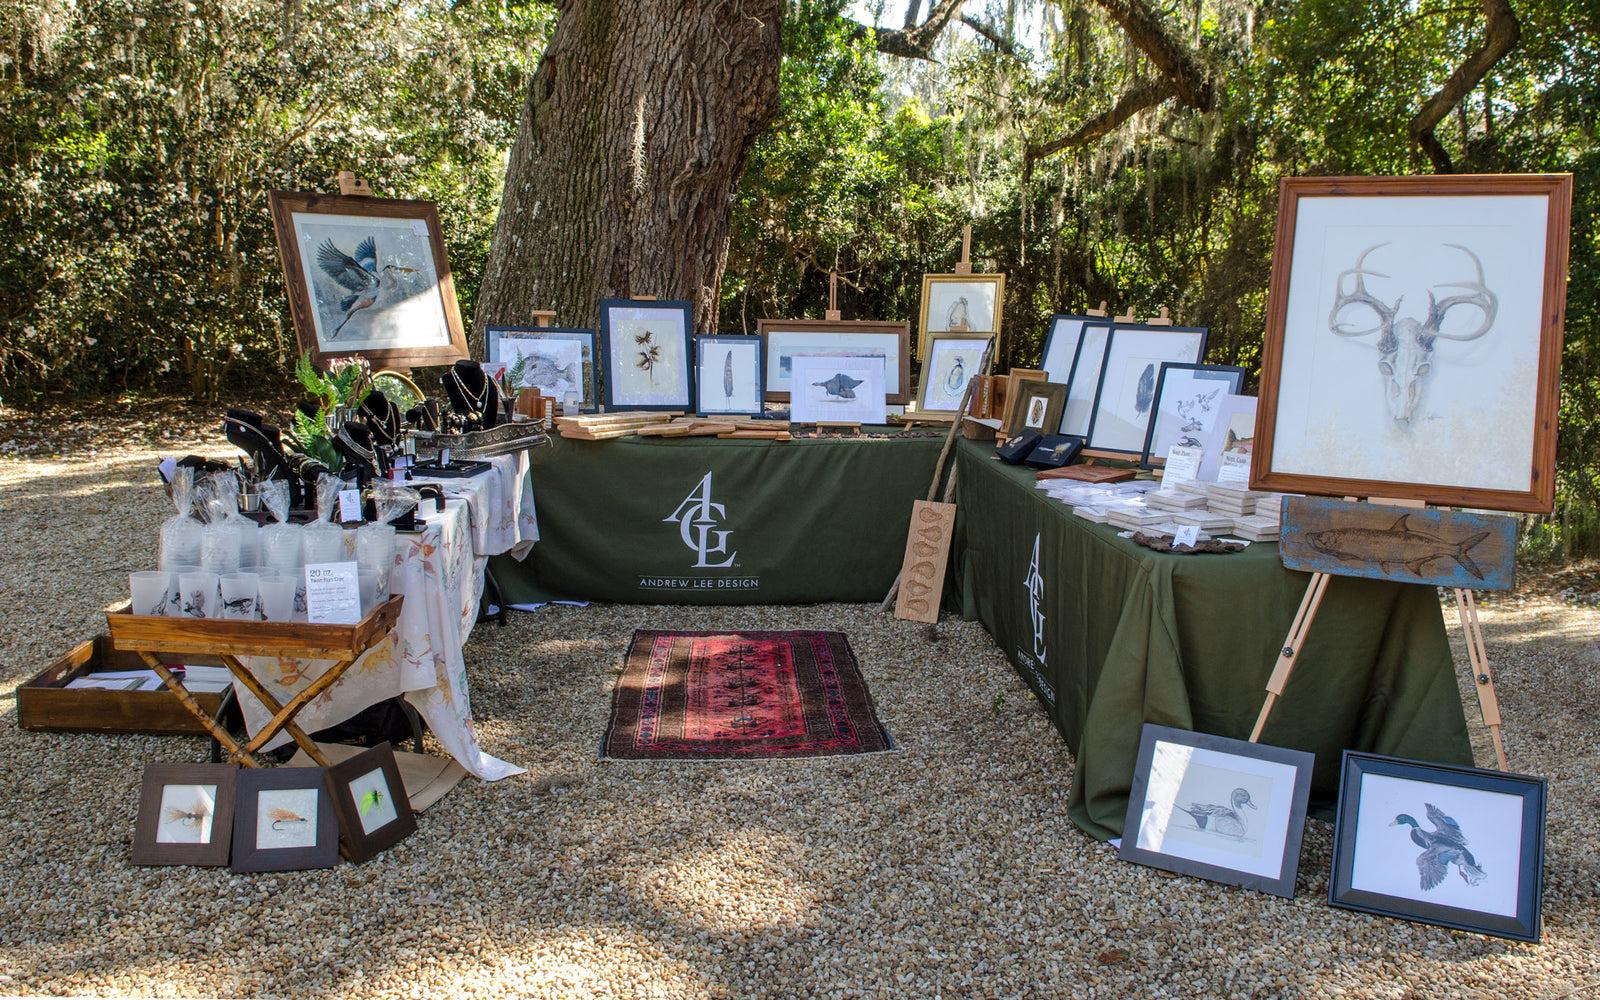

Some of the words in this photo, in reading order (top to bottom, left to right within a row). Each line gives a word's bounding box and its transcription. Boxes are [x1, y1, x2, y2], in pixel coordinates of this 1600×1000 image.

[640, 578, 689, 588] ANDREW
[693, 579, 713, 588] LEE
[717, 579, 759, 588] DESIGN
